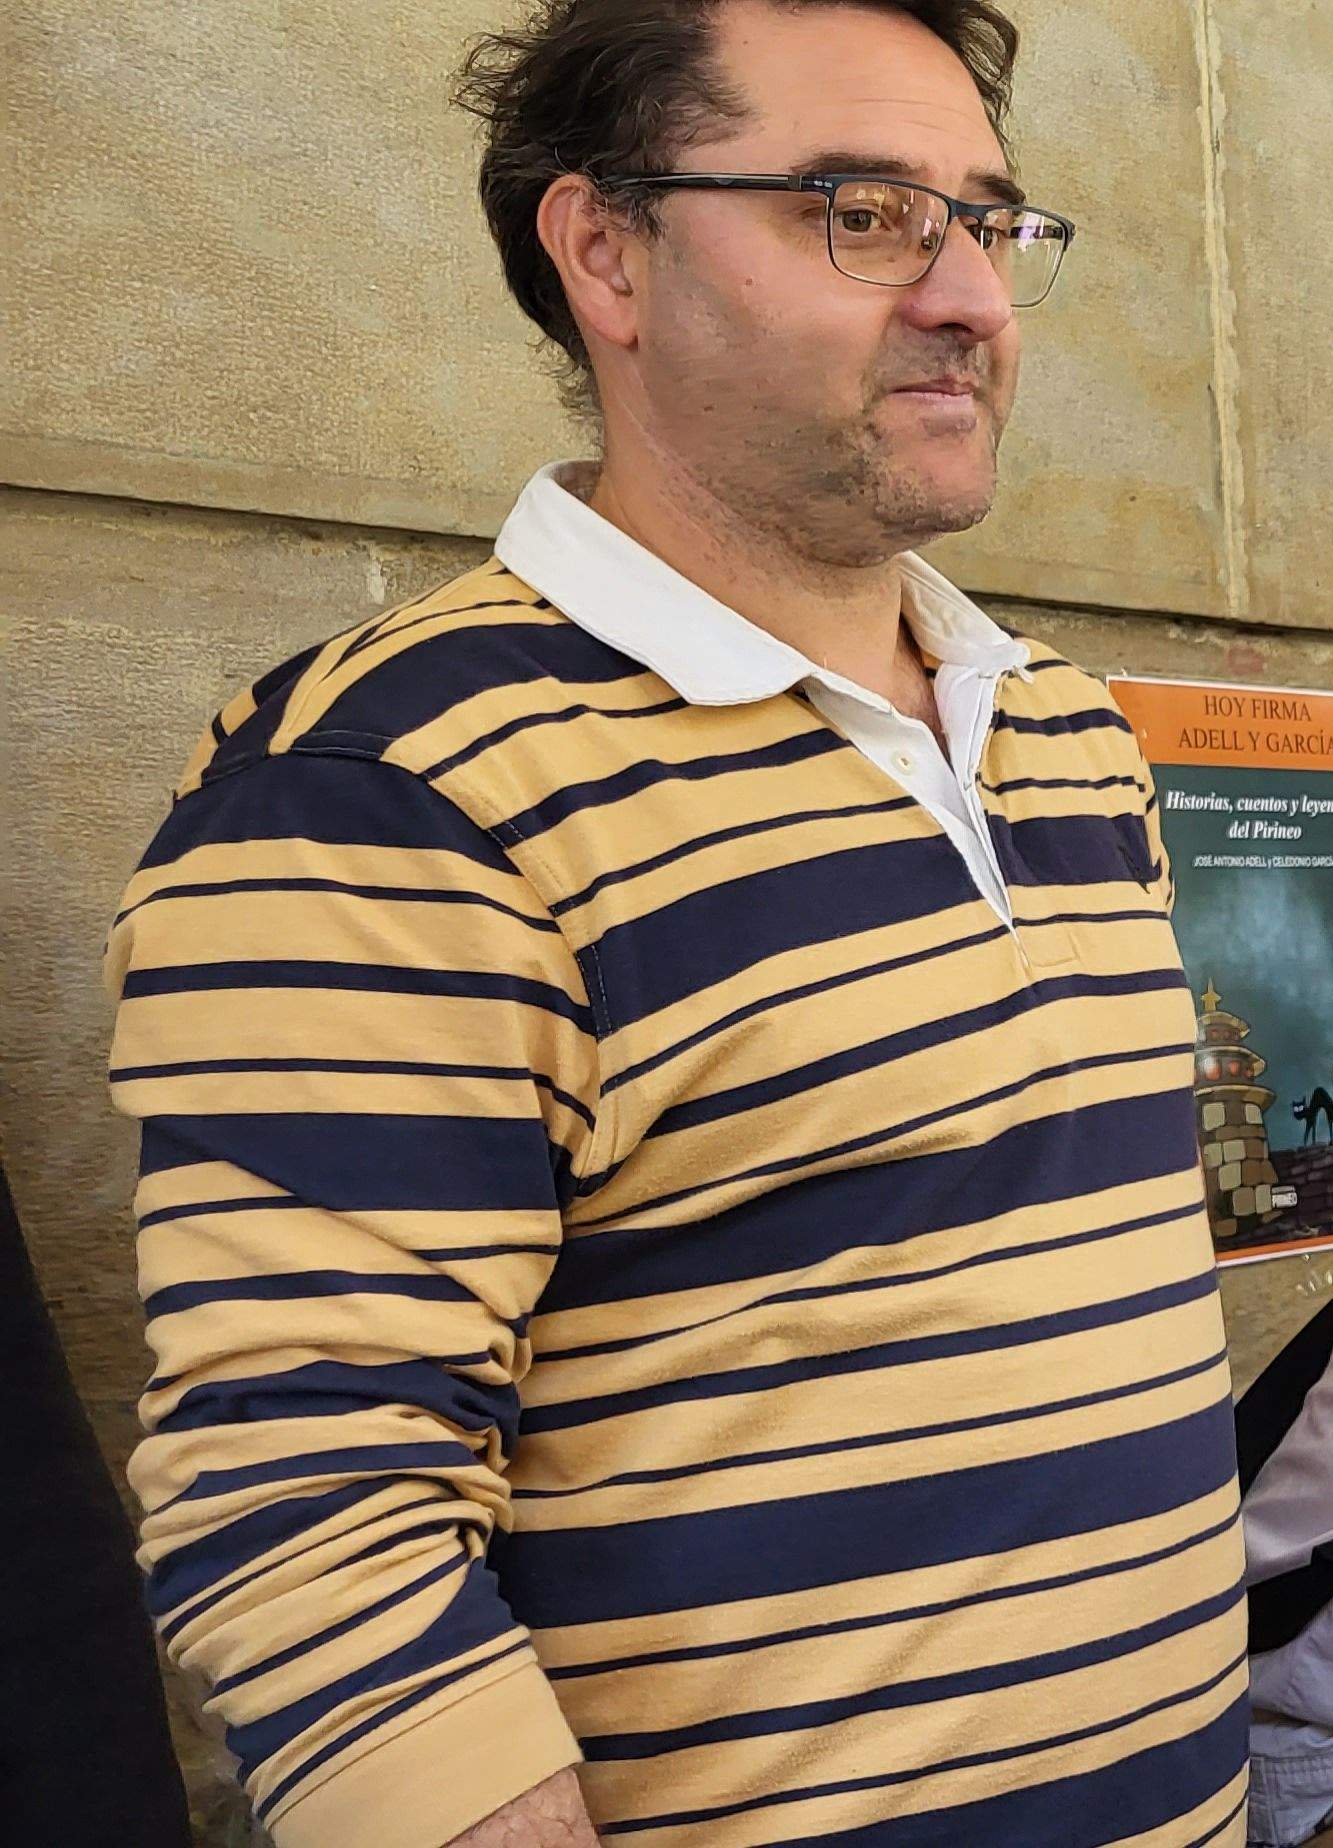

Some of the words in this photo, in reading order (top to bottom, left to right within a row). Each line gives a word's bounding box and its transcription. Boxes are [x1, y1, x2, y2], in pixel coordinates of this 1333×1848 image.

[1204, 696, 1246, 718] HOY
[1252, 698, 1312, 721] FIRMA
[1179, 728, 1244, 750] ADELL
[1249, 732, 1260, 751] Y
[1166, 790, 1234, 814] Historias,
[1237, 796, 1288, 812] cuentos
[1288, 799, 1300, 817] y
[1228, 820, 1250, 839] del
[1252, 820, 1302, 840] Pirineo
[1193, 854, 1213, 868] JOSÉ
[1213, 855, 1245, 867] ANTONIO
[1245, 856, 1267, 868] ADELL
[1273, 855, 1311, 868] CELEDONIO
